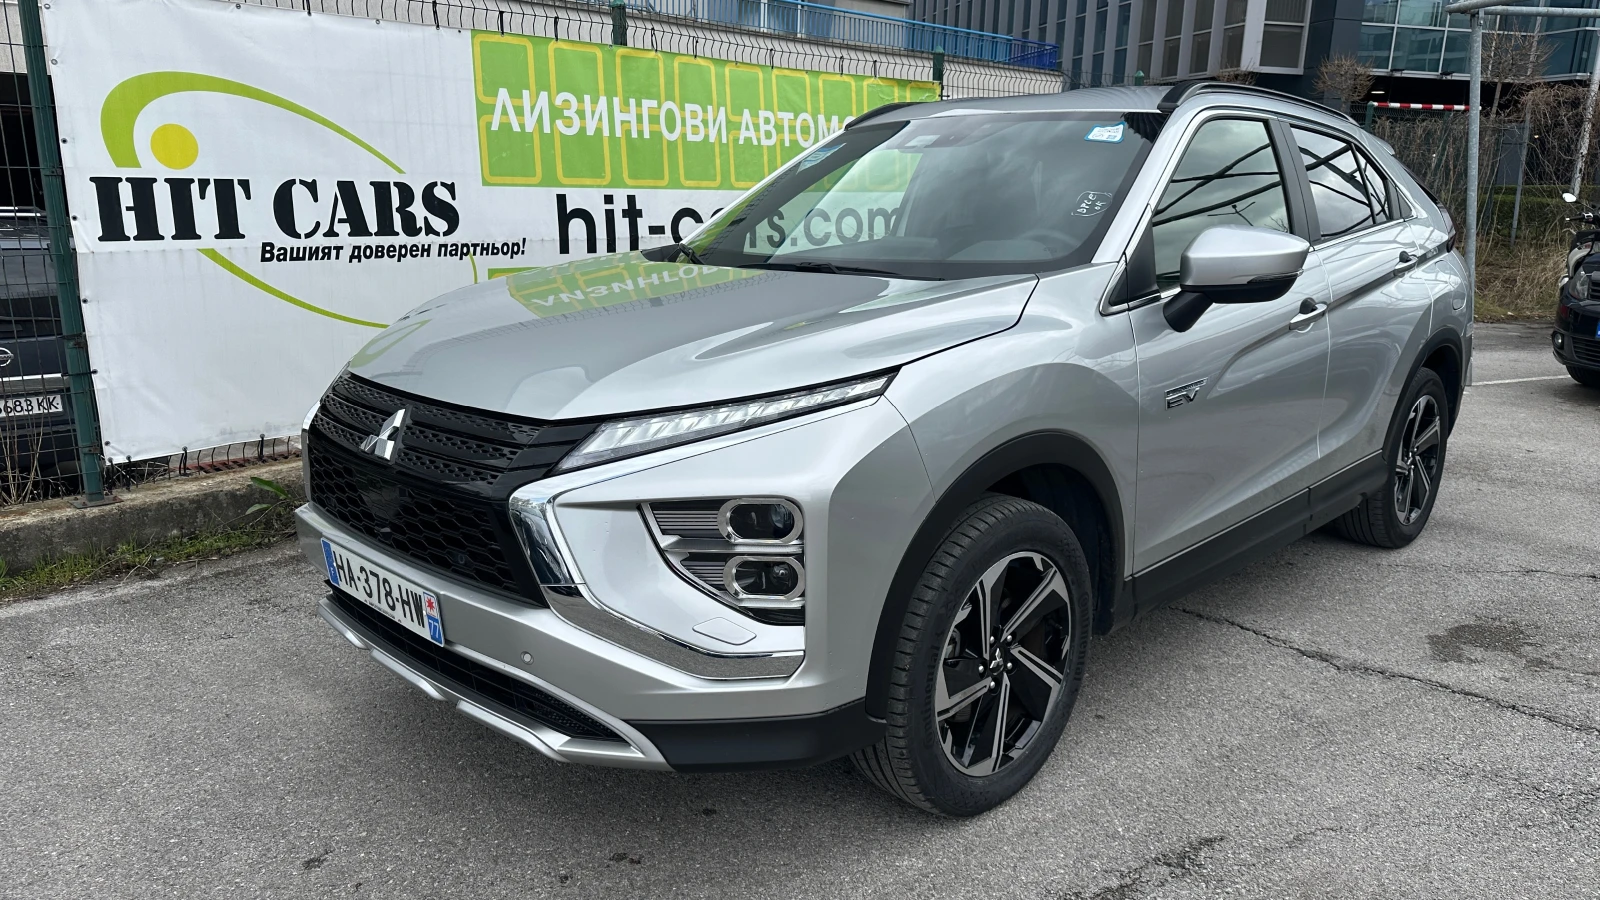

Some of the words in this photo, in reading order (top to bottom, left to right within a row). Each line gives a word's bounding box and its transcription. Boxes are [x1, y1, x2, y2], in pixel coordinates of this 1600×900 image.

[490, 87, 727, 144] ЛИЗИНГОВИ
[89, 176, 252, 242] HIT
[272, 178, 460, 239] CARS
[260, 241, 344, 263] Вашият
[348, 243, 432, 263] доверен
[437, 238, 527, 261] партньор!
[333, 550, 425, 628] HA-378-HW
[428, 619, 439, 638] 77
